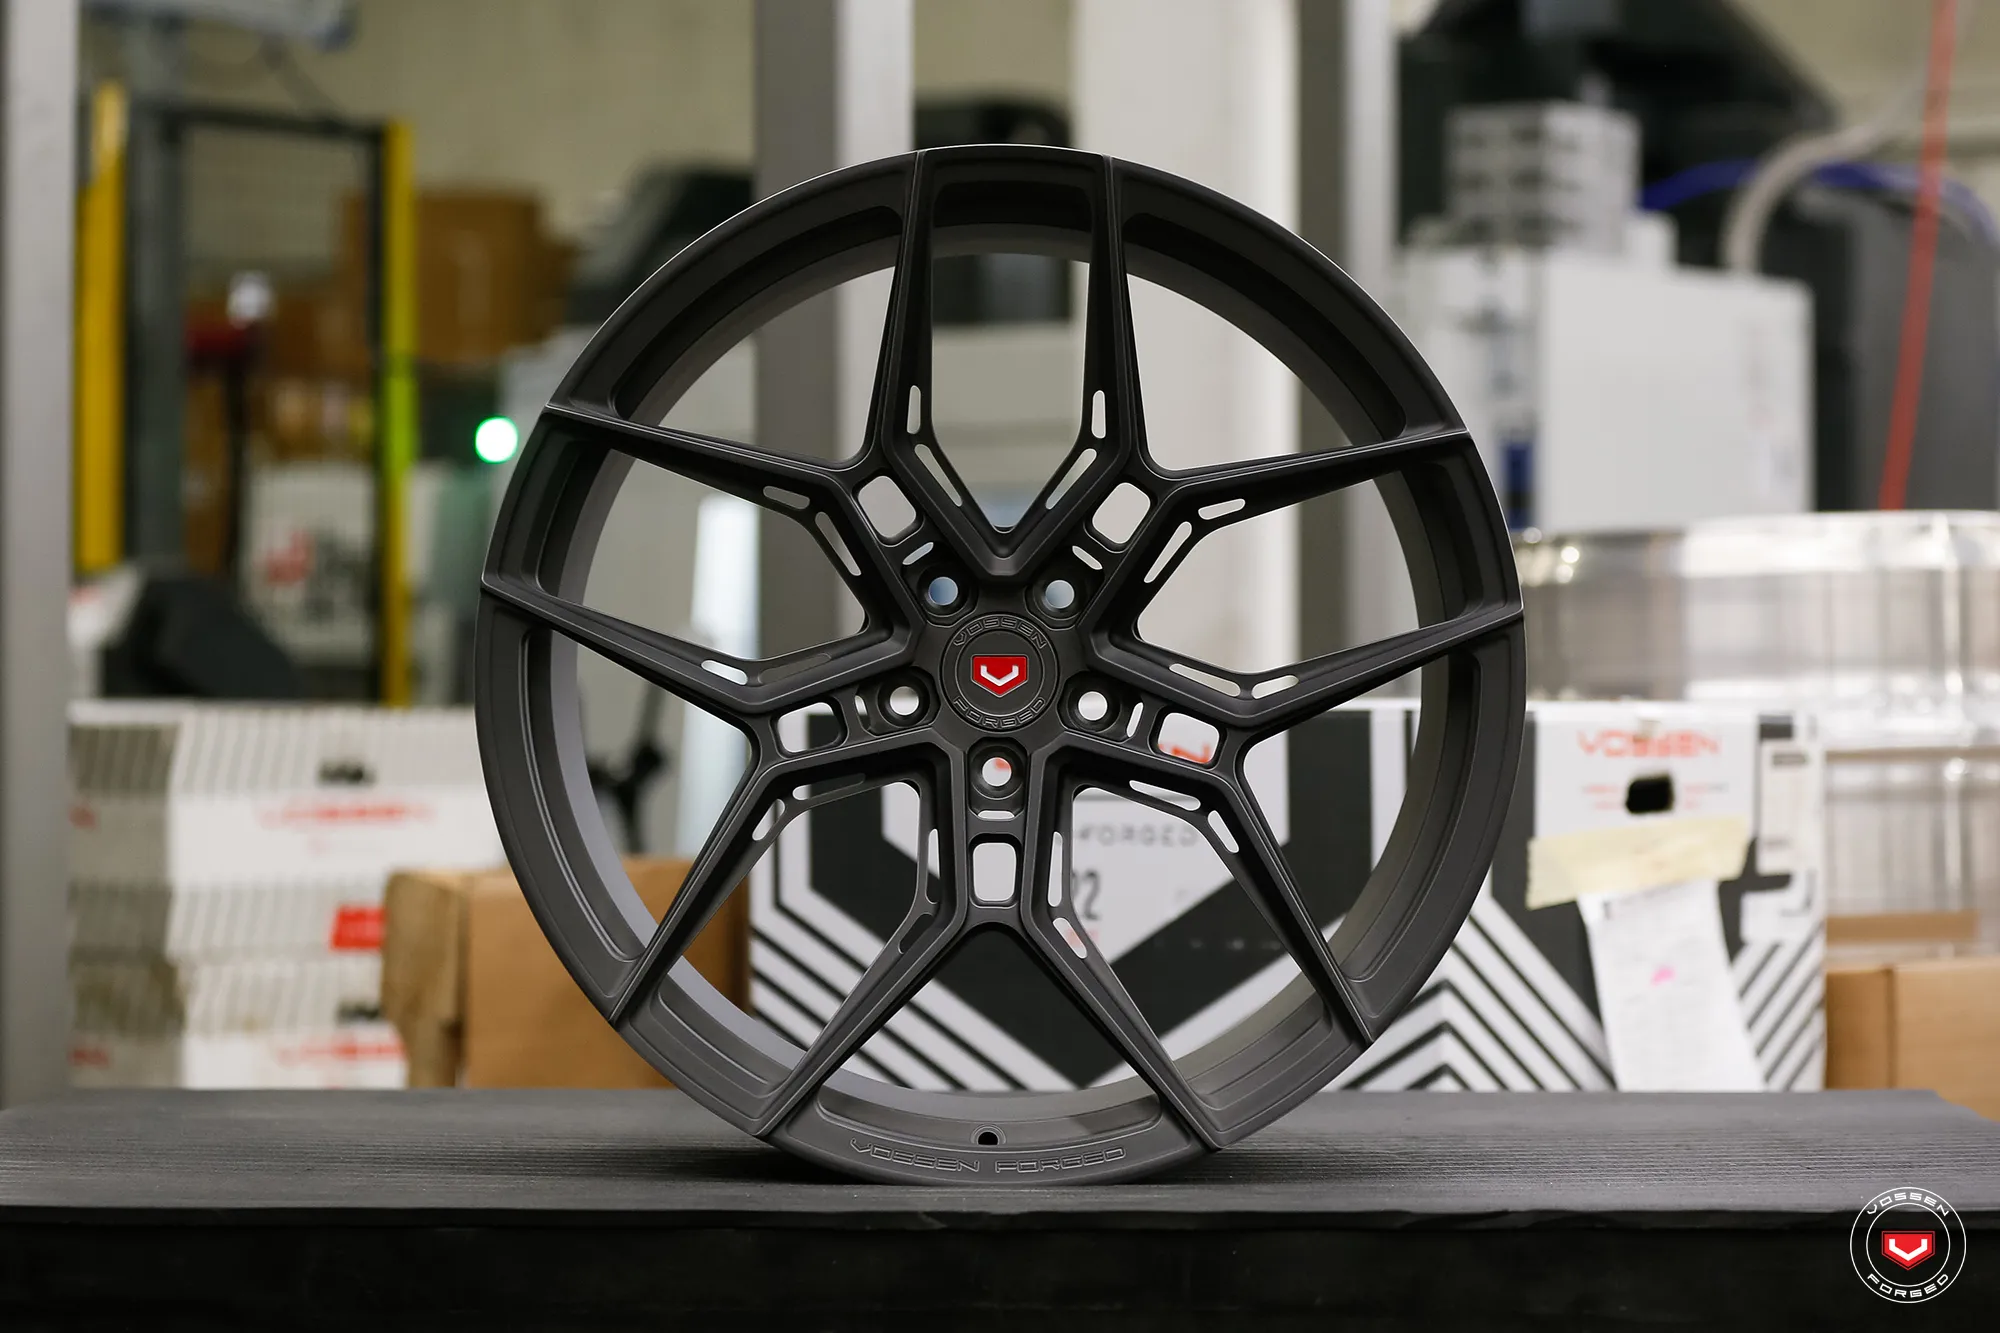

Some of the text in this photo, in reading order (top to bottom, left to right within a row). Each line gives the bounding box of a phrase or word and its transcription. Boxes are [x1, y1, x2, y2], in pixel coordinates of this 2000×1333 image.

[953, 616, 1047, 649] VOSSEN
[953, 696, 1046, 729] FORGED
[1576, 729, 1723, 758] VOSSEN
[850, 1138, 1127, 1173] VOSSEN FORGED
